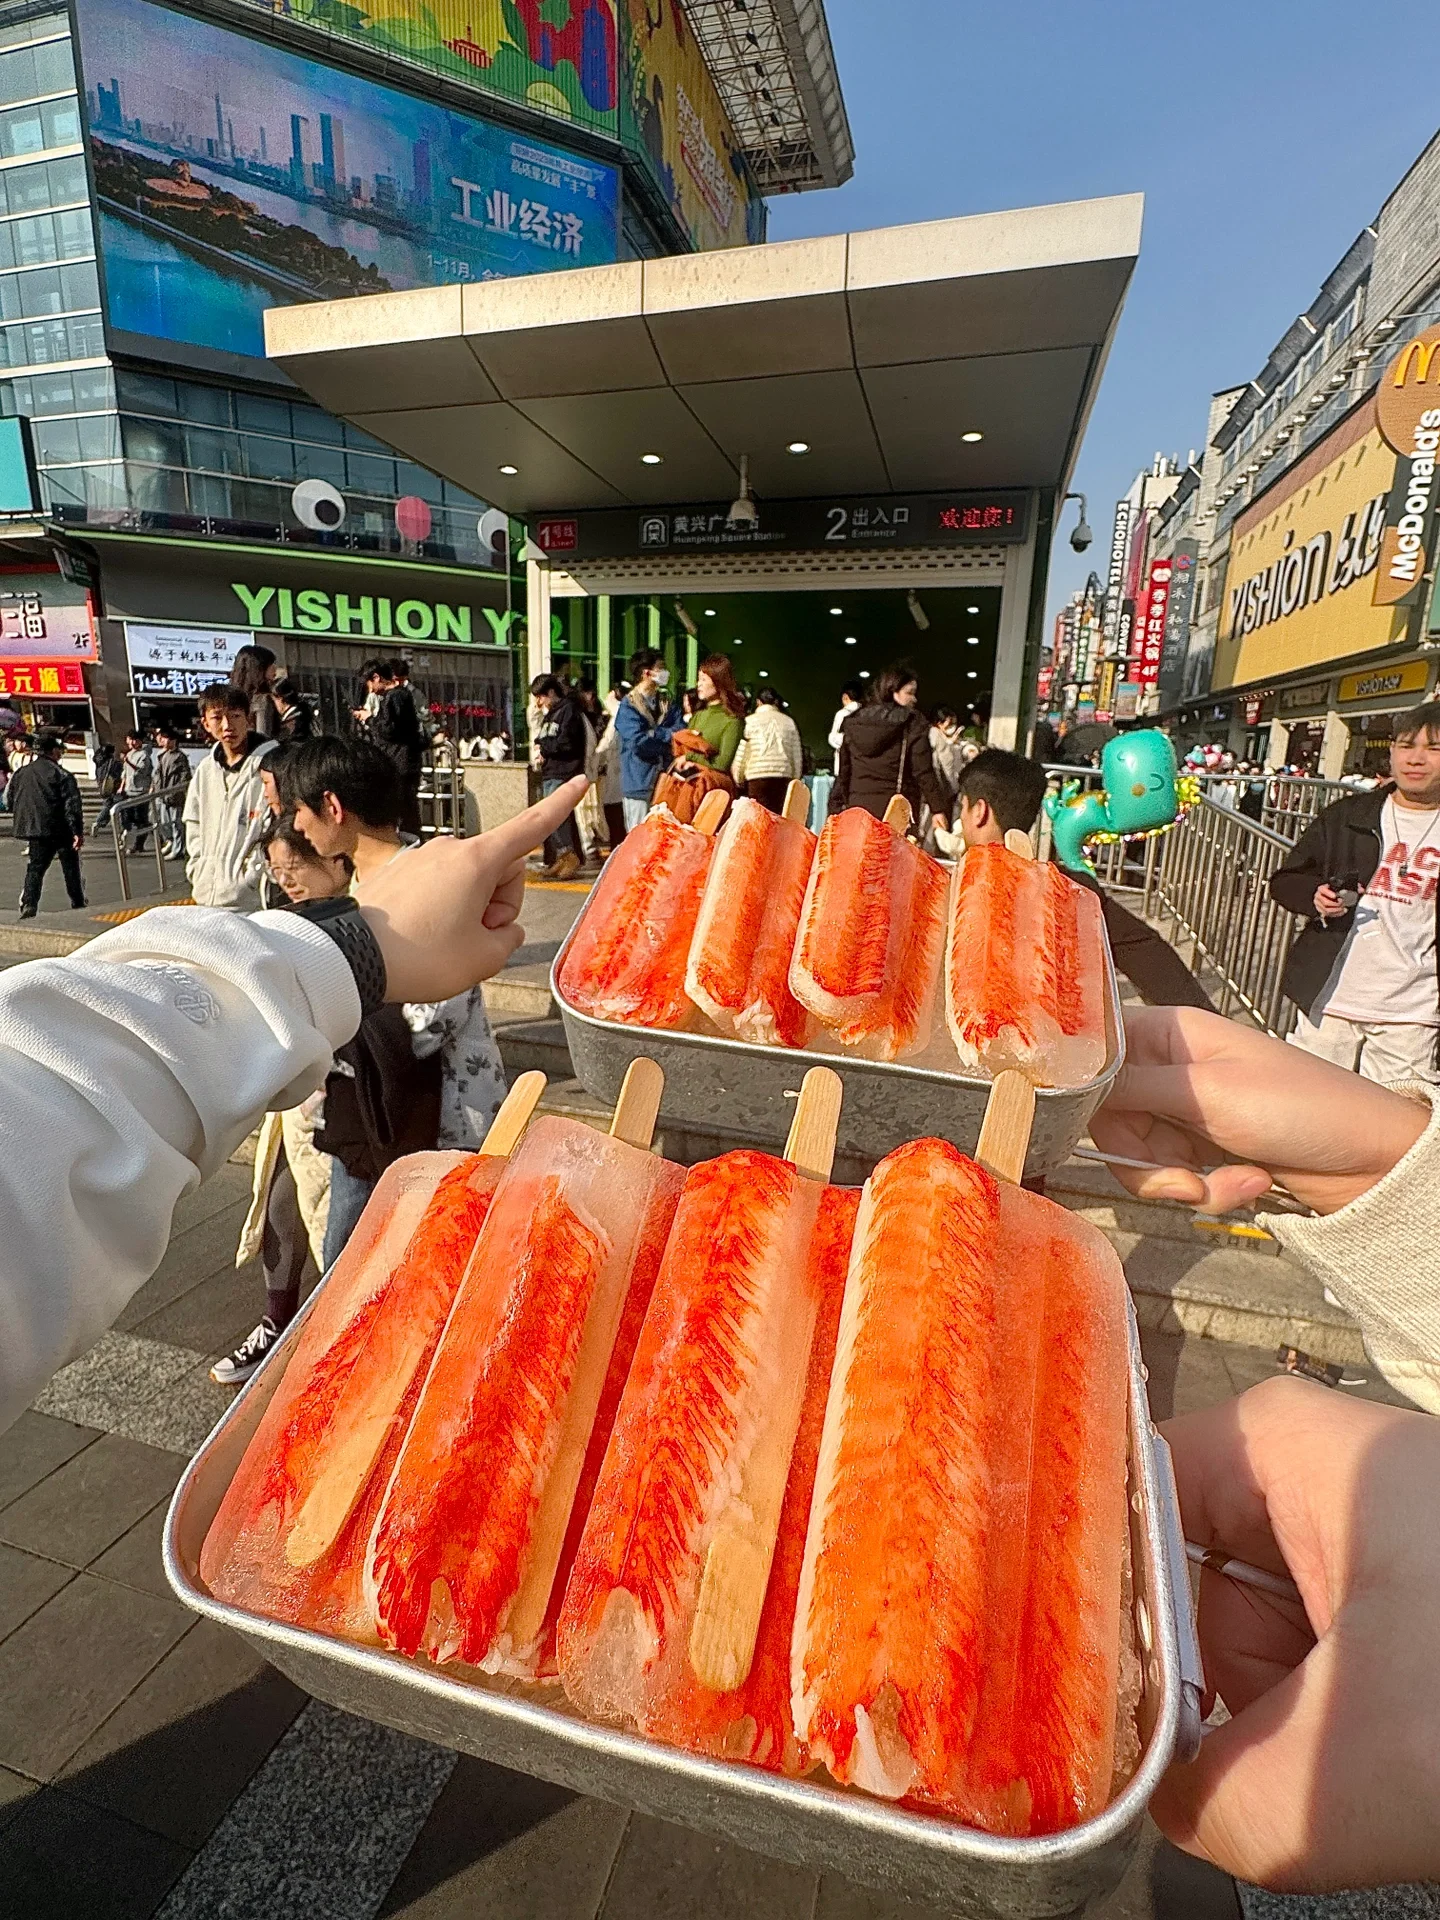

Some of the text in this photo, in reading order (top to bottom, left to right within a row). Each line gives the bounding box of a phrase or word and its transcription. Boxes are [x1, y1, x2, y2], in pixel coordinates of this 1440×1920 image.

[450, 176, 583, 259] 工业经济
[824, 507, 848, 541] 2
[852, 507, 909, 527] 出入口
[1389, 408, 1440, 582] McDonald's
[851, 529, 898, 538] Entrance
[231, 583, 472, 643] YISHION
[1145, 588, 1168, 661] 季季红火锅
